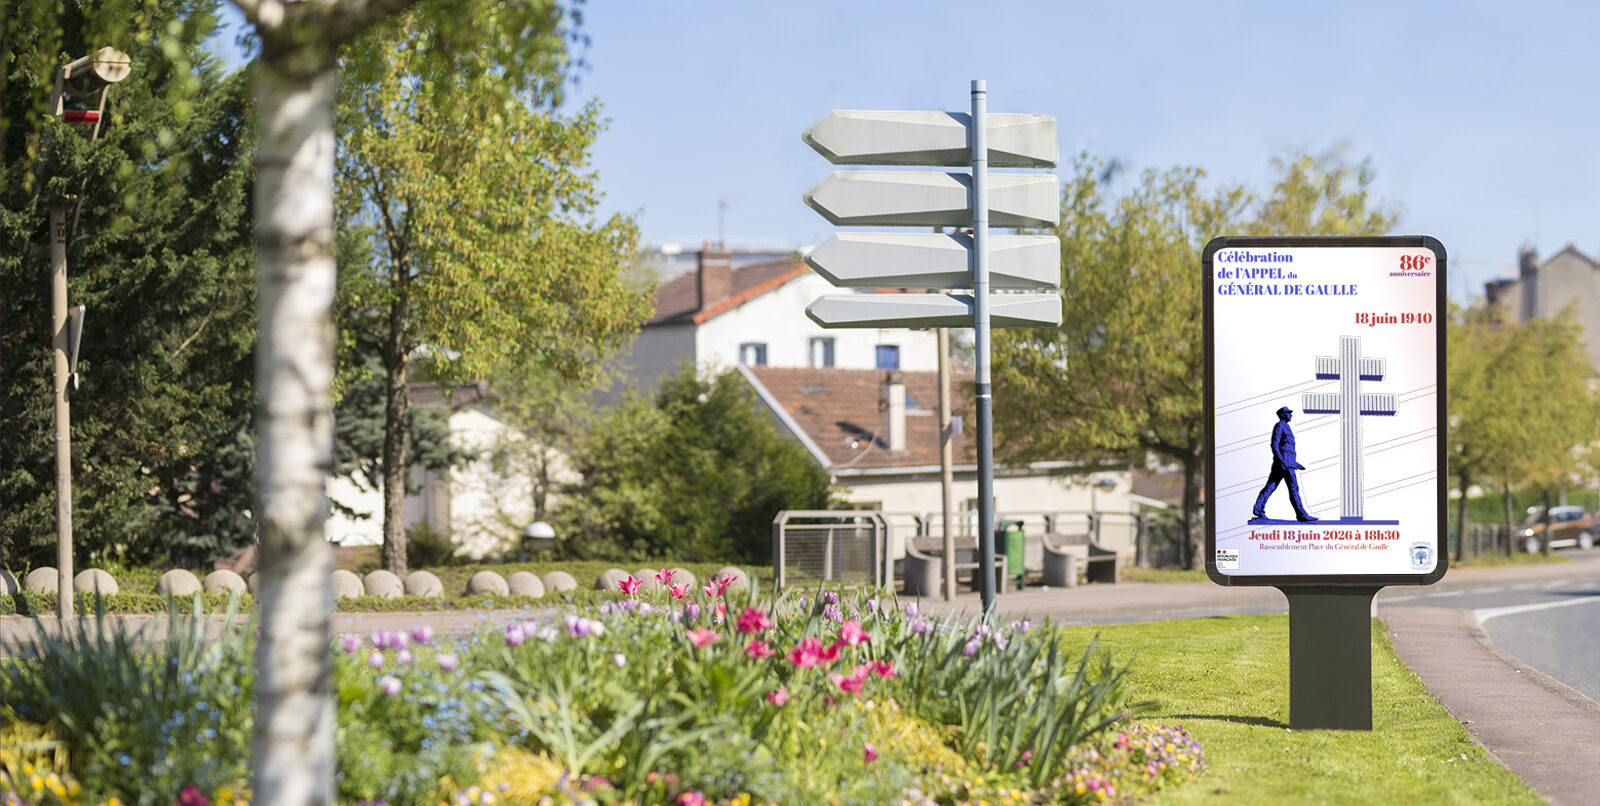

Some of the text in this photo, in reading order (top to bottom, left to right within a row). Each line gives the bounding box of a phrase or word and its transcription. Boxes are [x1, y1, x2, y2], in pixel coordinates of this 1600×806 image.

[1217, 250, 1293, 263] Célébration
[1217, 268, 1233, 279] de
[1287, 271, 1298, 279] du
[1217, 281, 1358, 296] GÉNÉRAL DE GAULLE
[1355, 312, 1433, 327] 18 juin 1940
[1248, 530, 1400, 543] Jeudi 18 juin 2026 à 18h30
[1259, 543, 1389, 551] Rassemblement Place du Général de Gaulle
